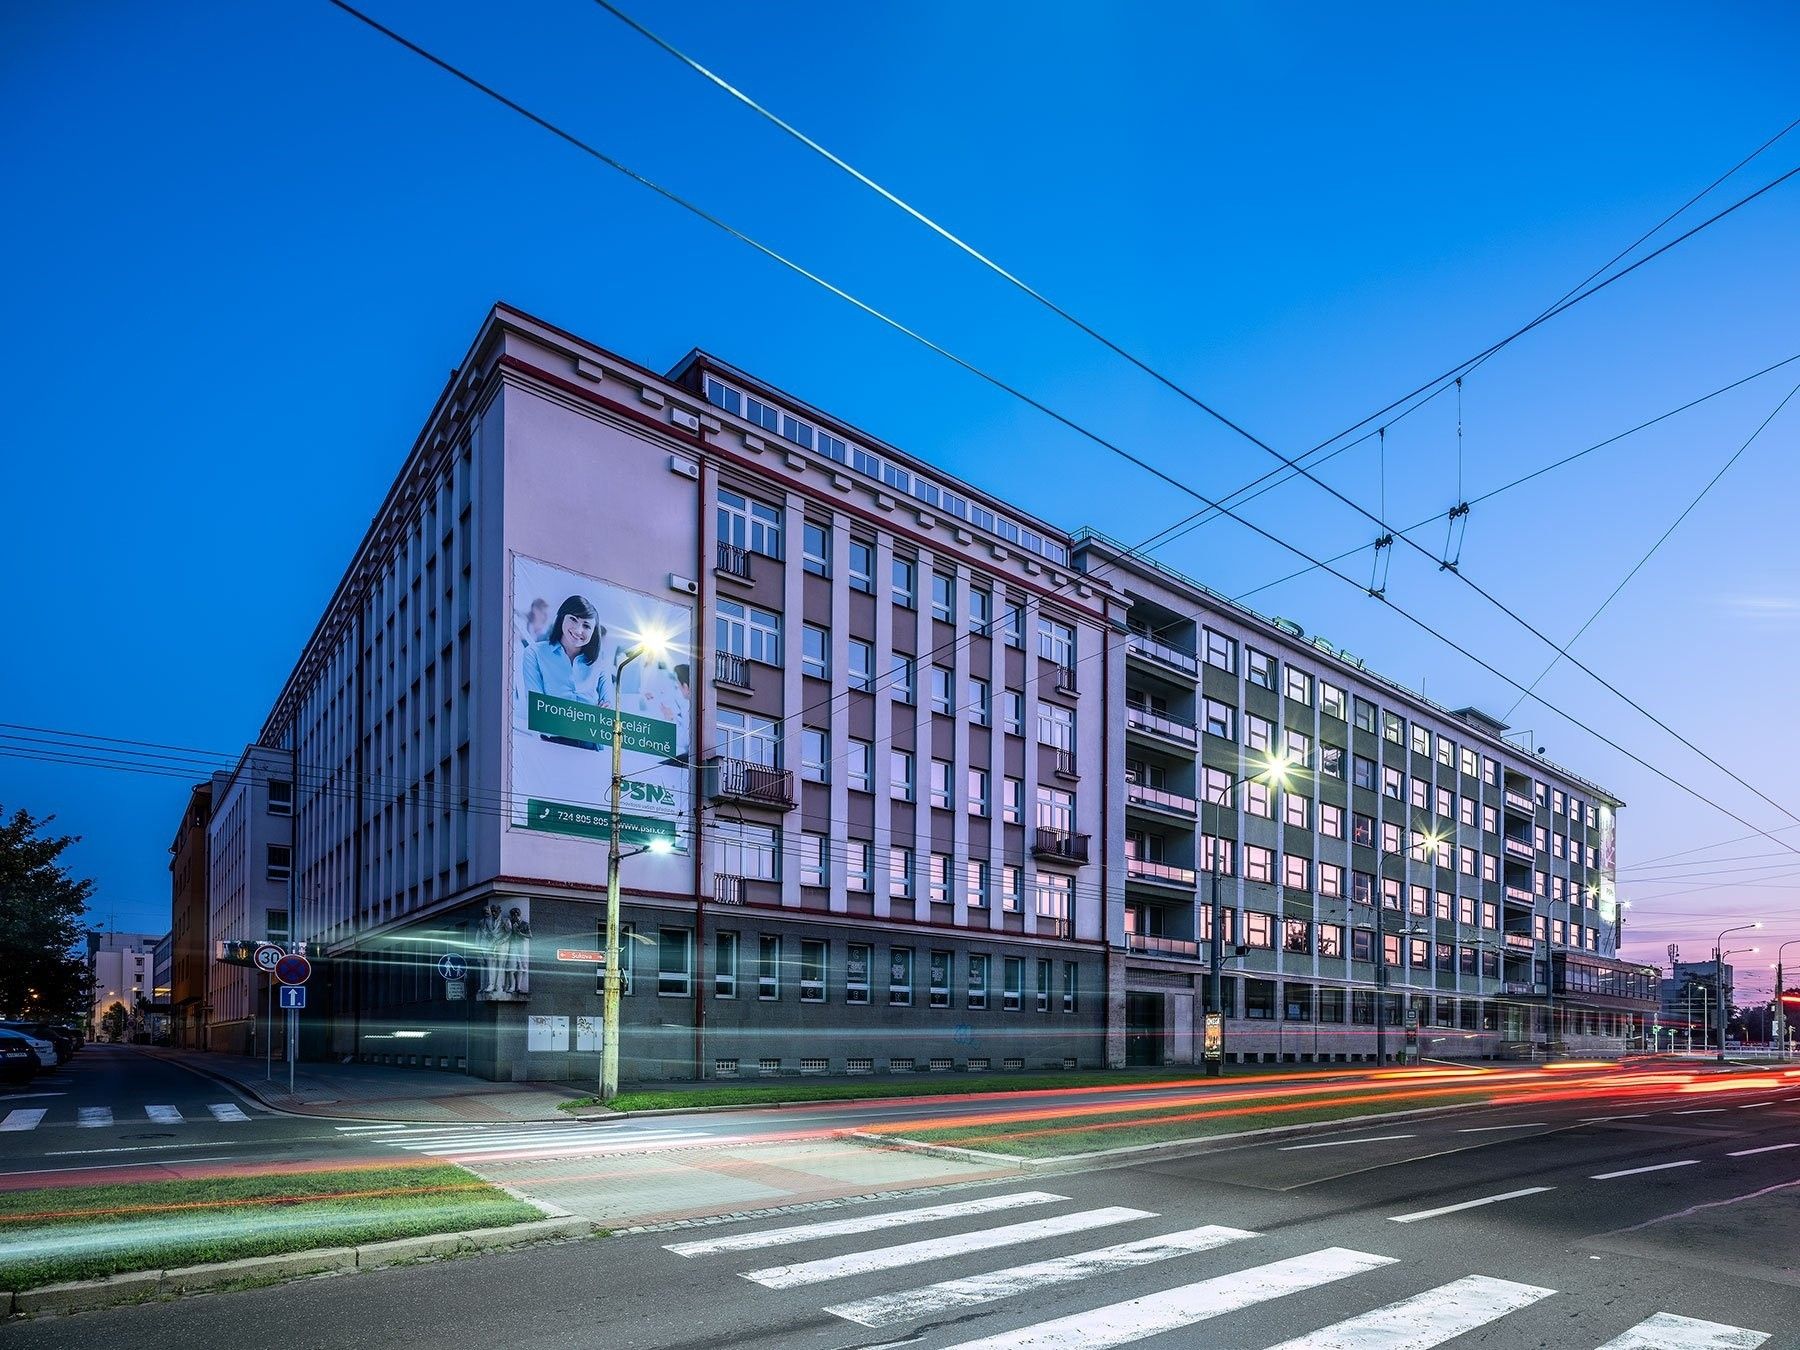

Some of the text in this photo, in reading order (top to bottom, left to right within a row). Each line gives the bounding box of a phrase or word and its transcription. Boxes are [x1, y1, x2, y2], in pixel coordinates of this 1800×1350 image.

[537, 699, 652, 735] Pronájem kaceláří
[589, 728, 671, 752] v toto domě
[557, 811, 573, 821] 724
[575, 813, 592, 824] 805
[593, 816, 609, 827] 805
[261, 951, 280, 965] 30
